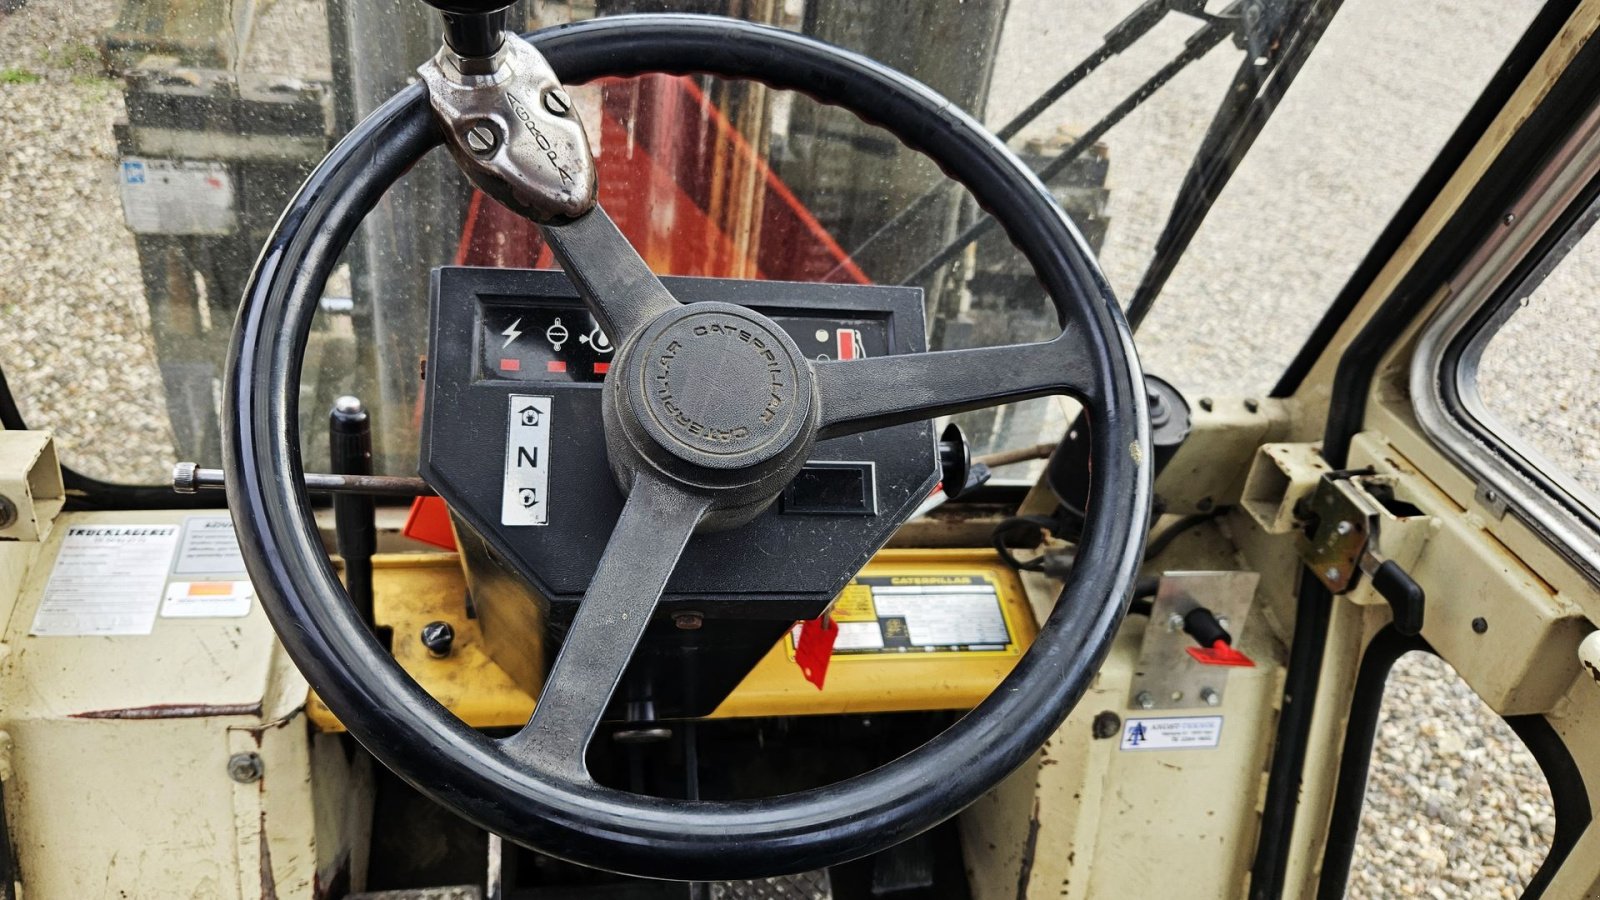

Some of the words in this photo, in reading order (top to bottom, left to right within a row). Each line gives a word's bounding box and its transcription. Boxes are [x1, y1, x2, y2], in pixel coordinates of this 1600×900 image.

[505, 92, 575, 185] AGROPA
[656, 339, 749, 442] CATERPILLAR
[692, 323, 784, 425] CATERPILLAR
[517, 446, 538, 468] N
[890, 576, 972, 585] CATERPILLAR
